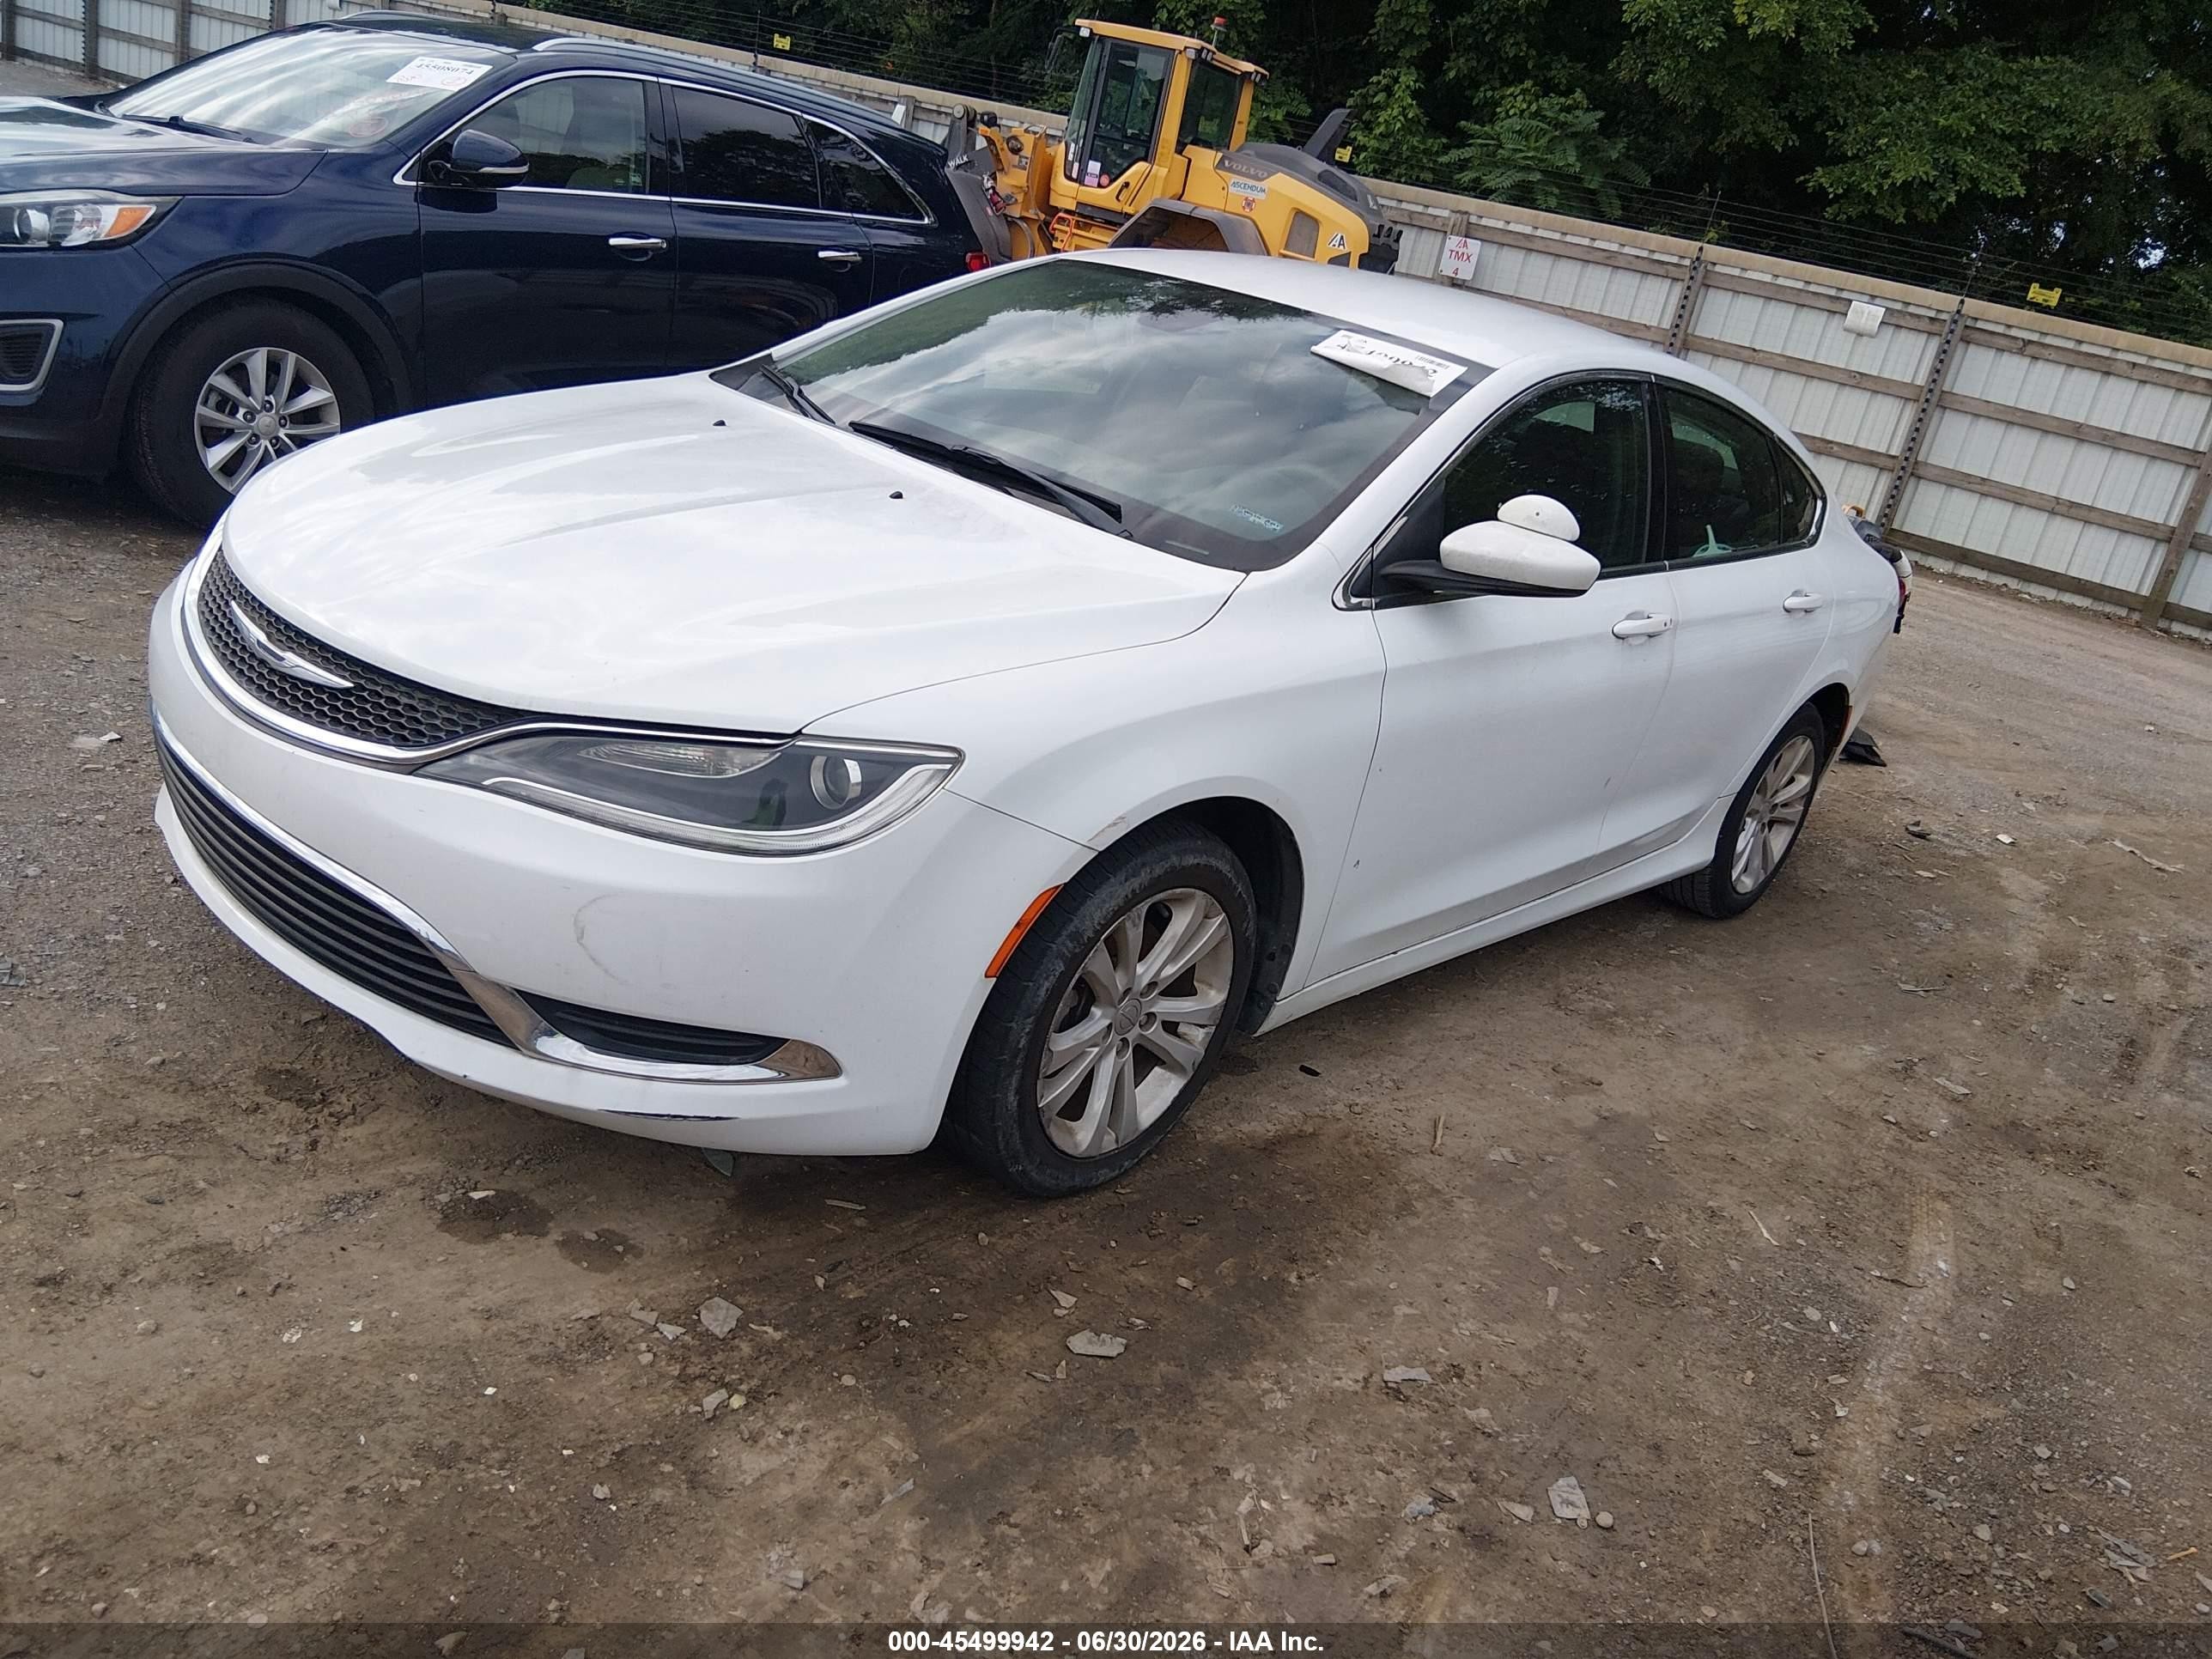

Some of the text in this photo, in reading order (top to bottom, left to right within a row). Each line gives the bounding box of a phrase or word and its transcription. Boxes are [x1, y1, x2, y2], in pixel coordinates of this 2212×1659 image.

[947, 154, 969, 168] WALK
[1224, 159, 1268, 179] VOLVO
[1449, 249, 1473, 263] TMX
[1452, 267, 1459, 276] 4
